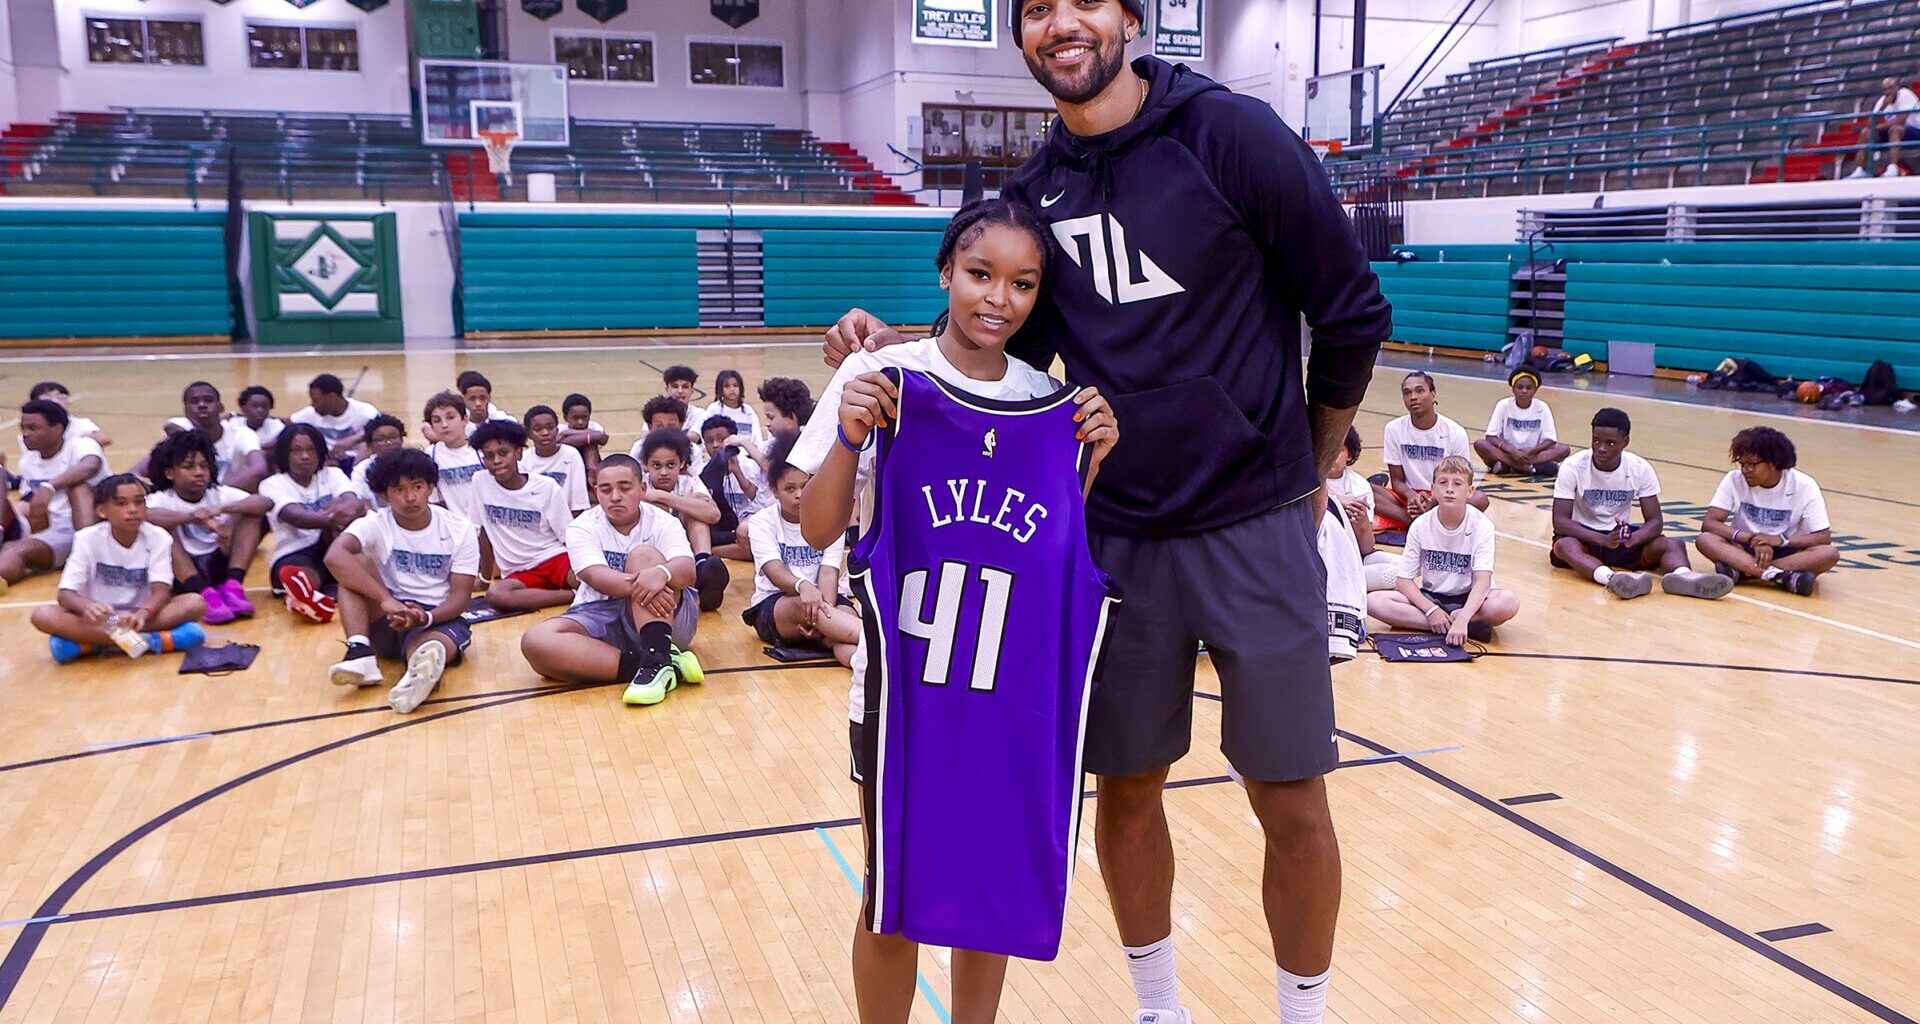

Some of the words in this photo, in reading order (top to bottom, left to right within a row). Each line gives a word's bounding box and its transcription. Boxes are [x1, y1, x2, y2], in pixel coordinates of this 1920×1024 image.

[922, 10, 950, 22] TREY
[953, 12, 986, 25] LYLES
[921, 478, 1048, 543] LYLES
[1427, 550, 1447, 565] TREY
[1450, 553, 1469, 568] LYLES
[896, 560, 1014, 692] 41
